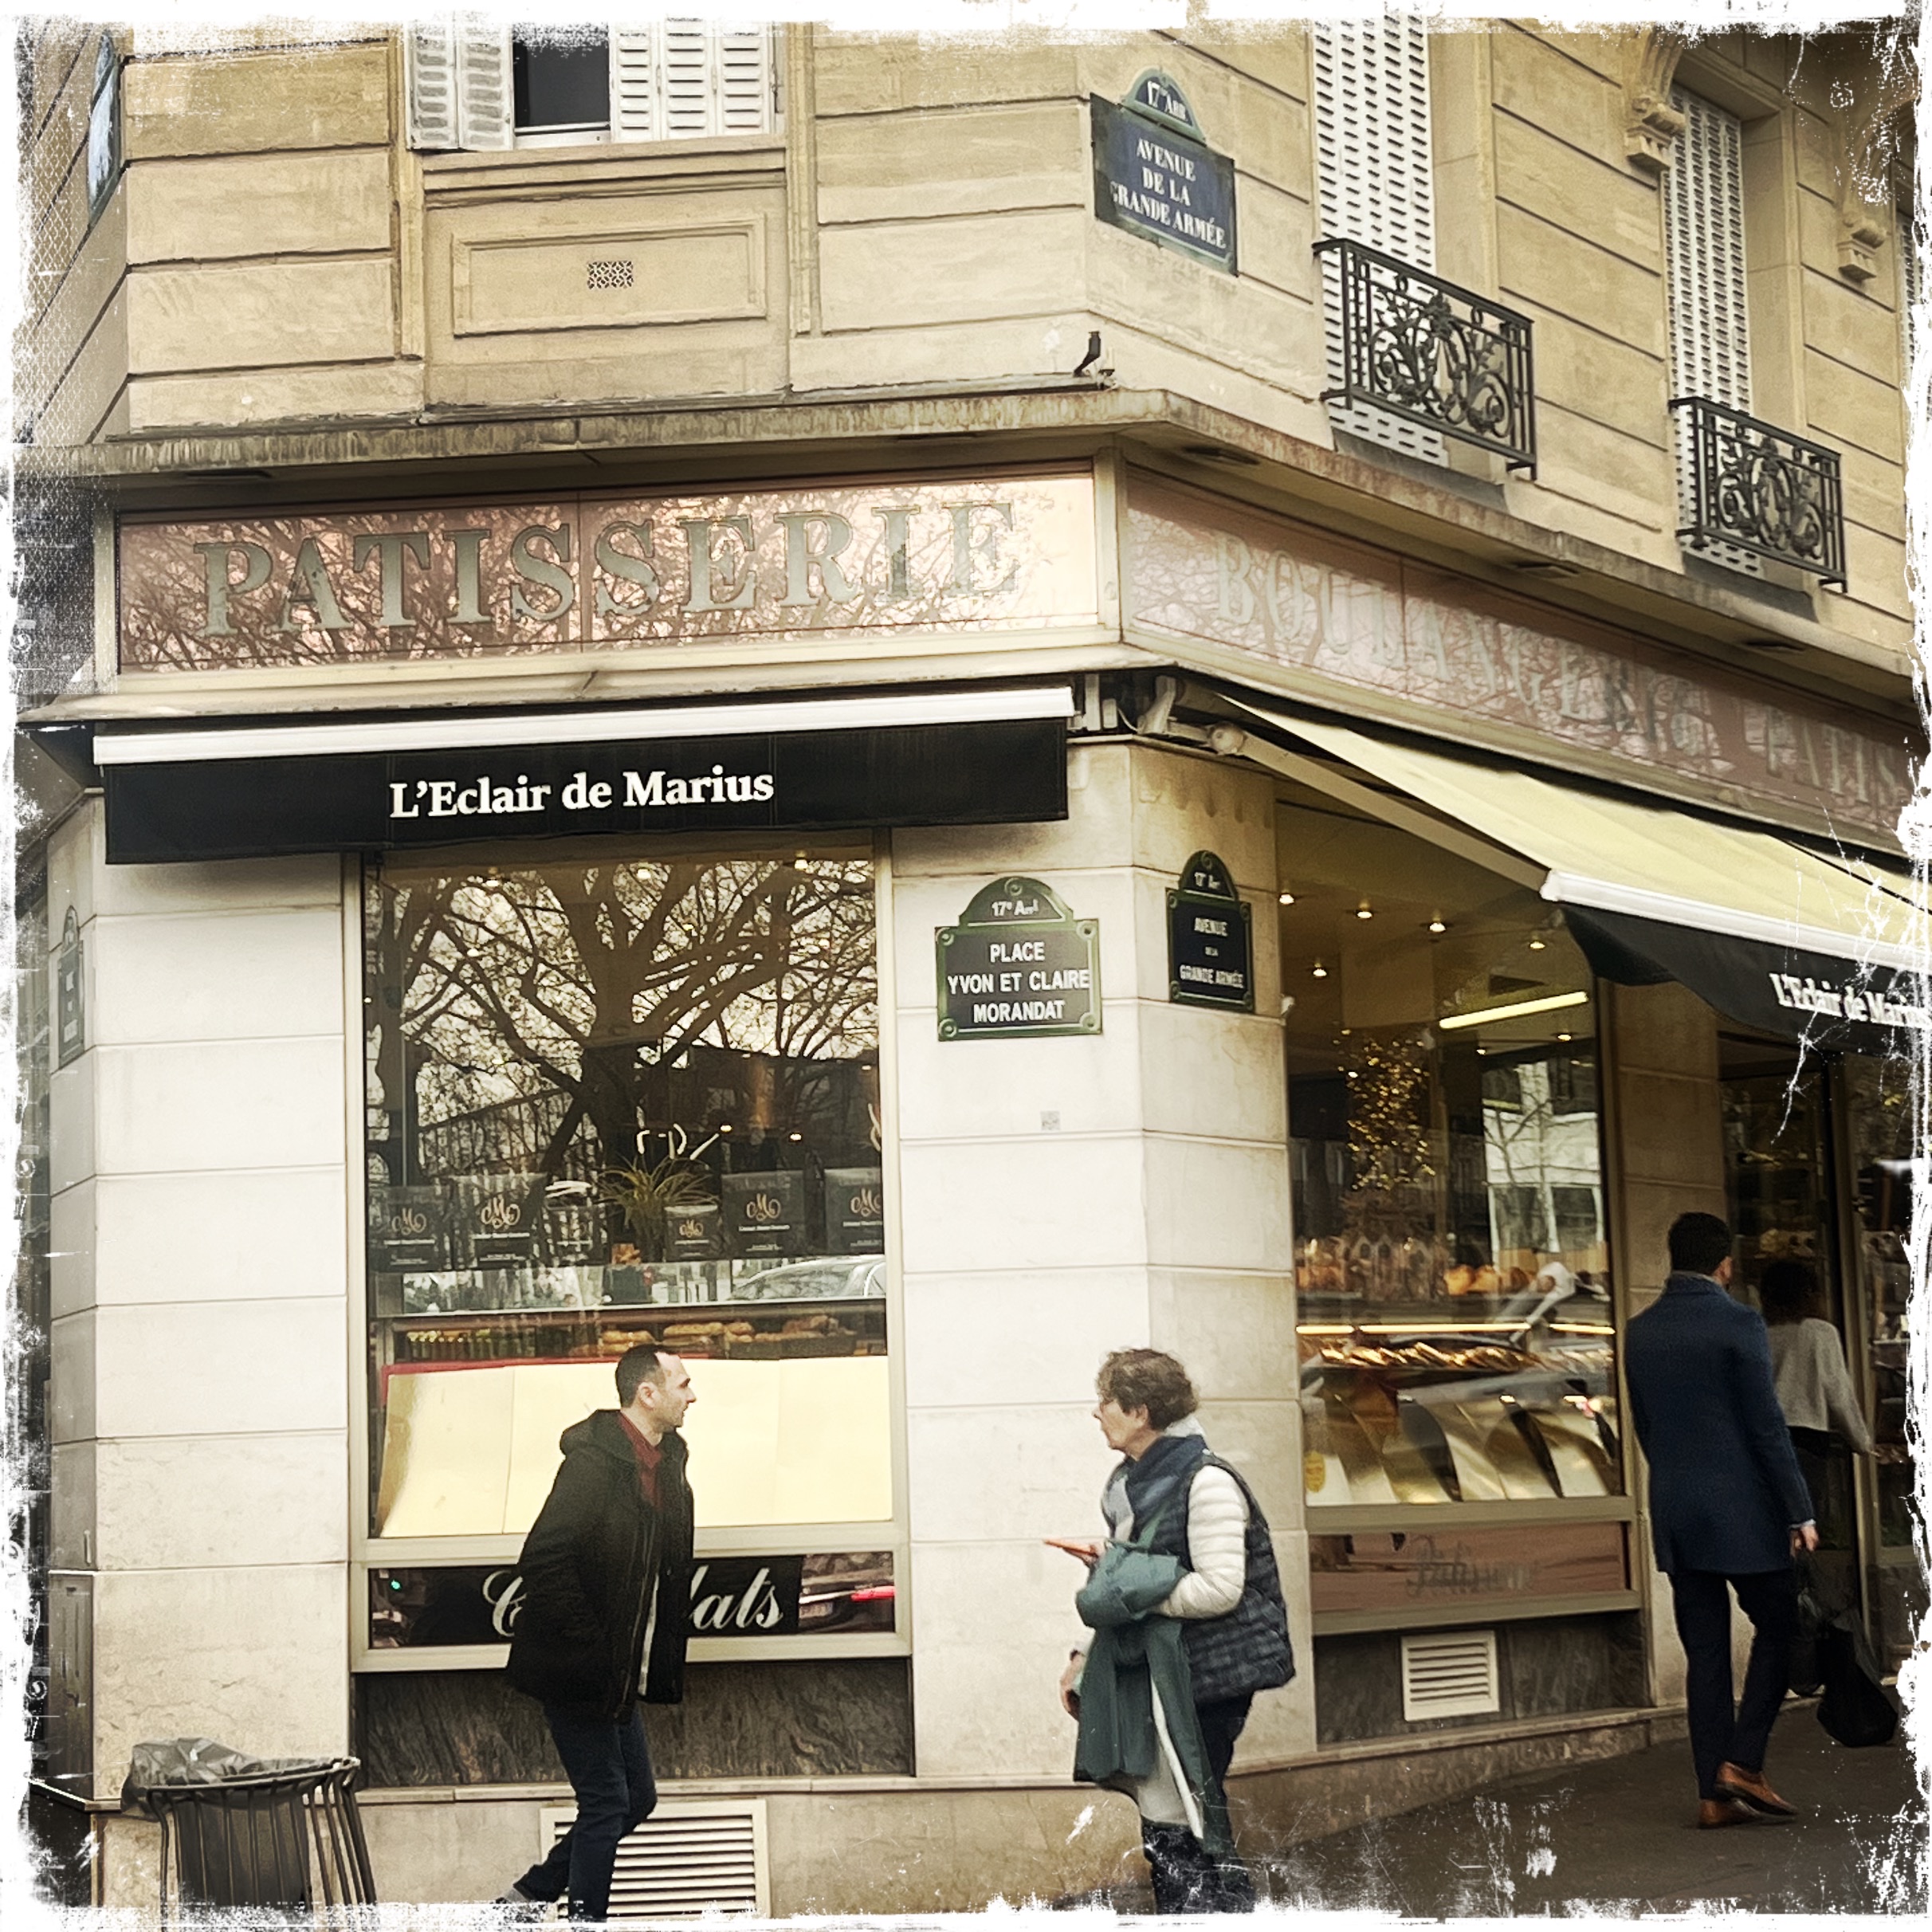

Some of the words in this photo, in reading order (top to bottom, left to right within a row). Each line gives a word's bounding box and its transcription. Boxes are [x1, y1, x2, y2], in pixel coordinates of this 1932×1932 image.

[1137, 138, 1196, 182] AVENUE
[1142, 166, 1165, 195] DE
[1169, 179, 1191, 206] LA
[1110, 181, 1171, 226] GRANDE
[1172, 210, 1227, 249] ARMÉE
[194, 499, 1019, 638] PATISSERIE
[389, 774, 552, 819] L'Eclair
[562, 773, 612, 810] de
[622, 764, 774, 807] Marius
[990, 941, 1045, 963] PLACE
[947, 973, 994, 995] YVON
[999, 972, 1023, 992] ET
[1028, 968, 1090, 991] CLAIRE
[973, 999, 1066, 1023] MORANDAT
